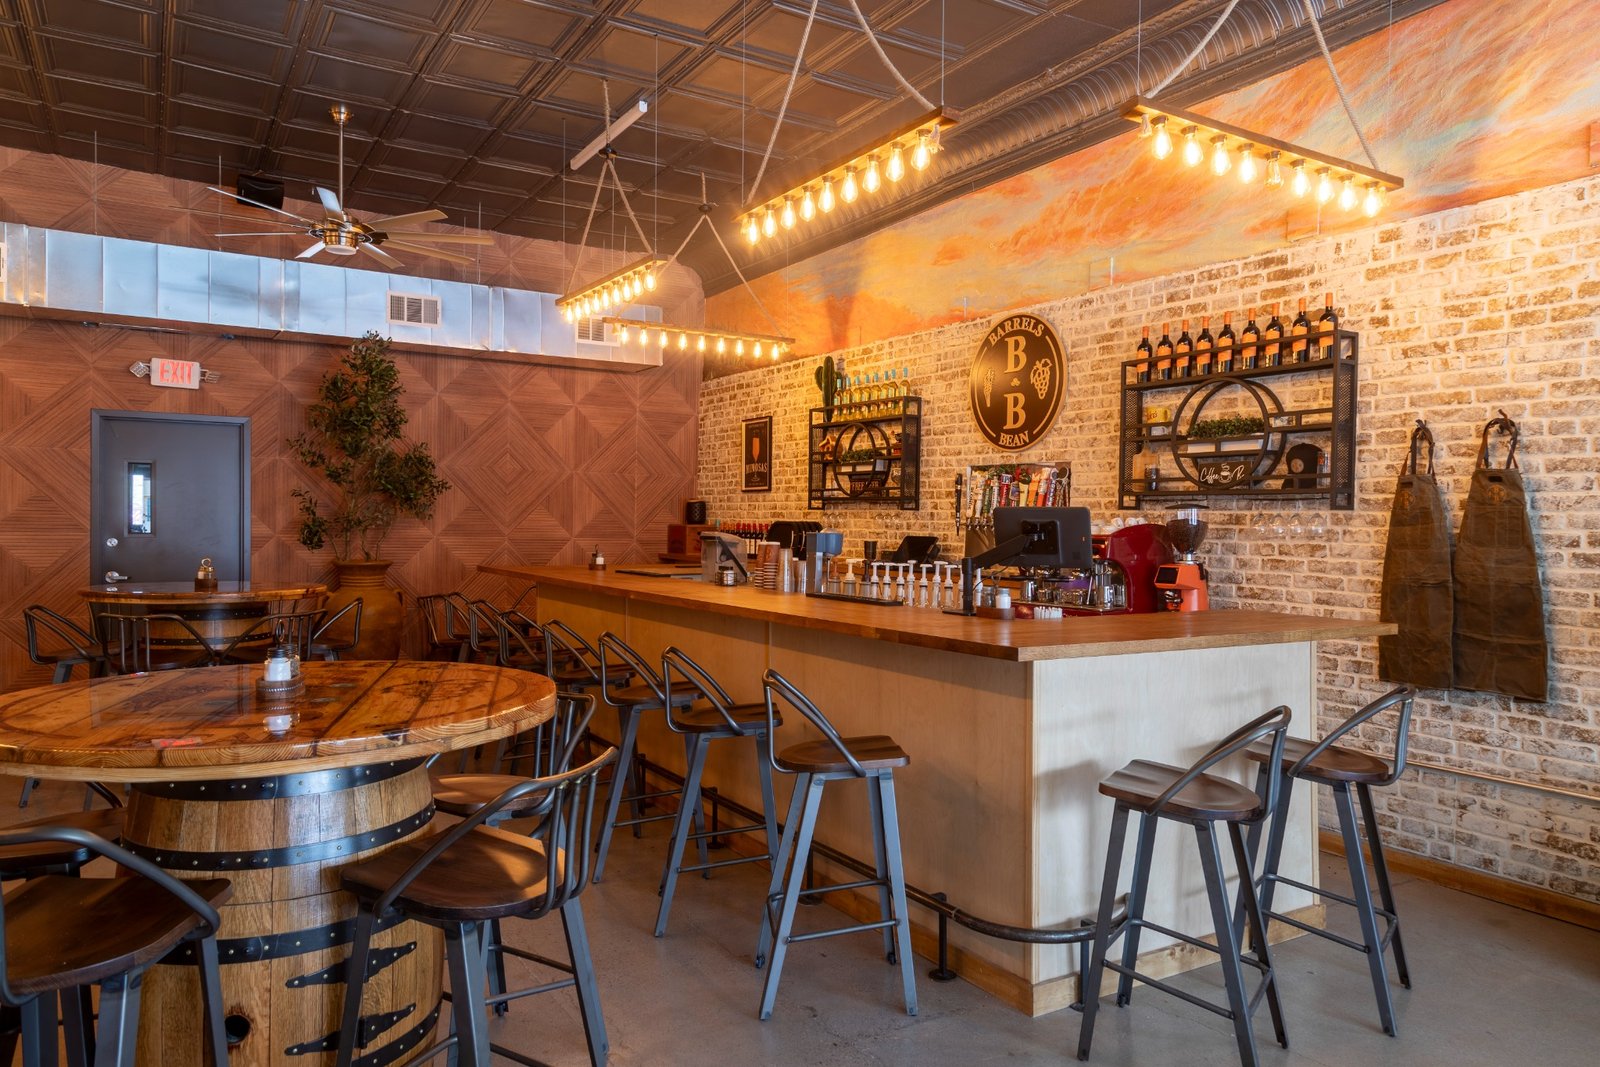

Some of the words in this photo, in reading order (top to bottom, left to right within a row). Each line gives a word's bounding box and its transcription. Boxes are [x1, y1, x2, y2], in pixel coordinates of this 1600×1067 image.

[988, 317, 1045, 347] BARRELS
[1004, 335, 1027, 374] B
[159, 360, 193, 384] EXIT
[1003, 392, 1027, 430] B
[998, 431, 1029, 447] BEAN
[1200, 467, 1219, 484] Coffee
